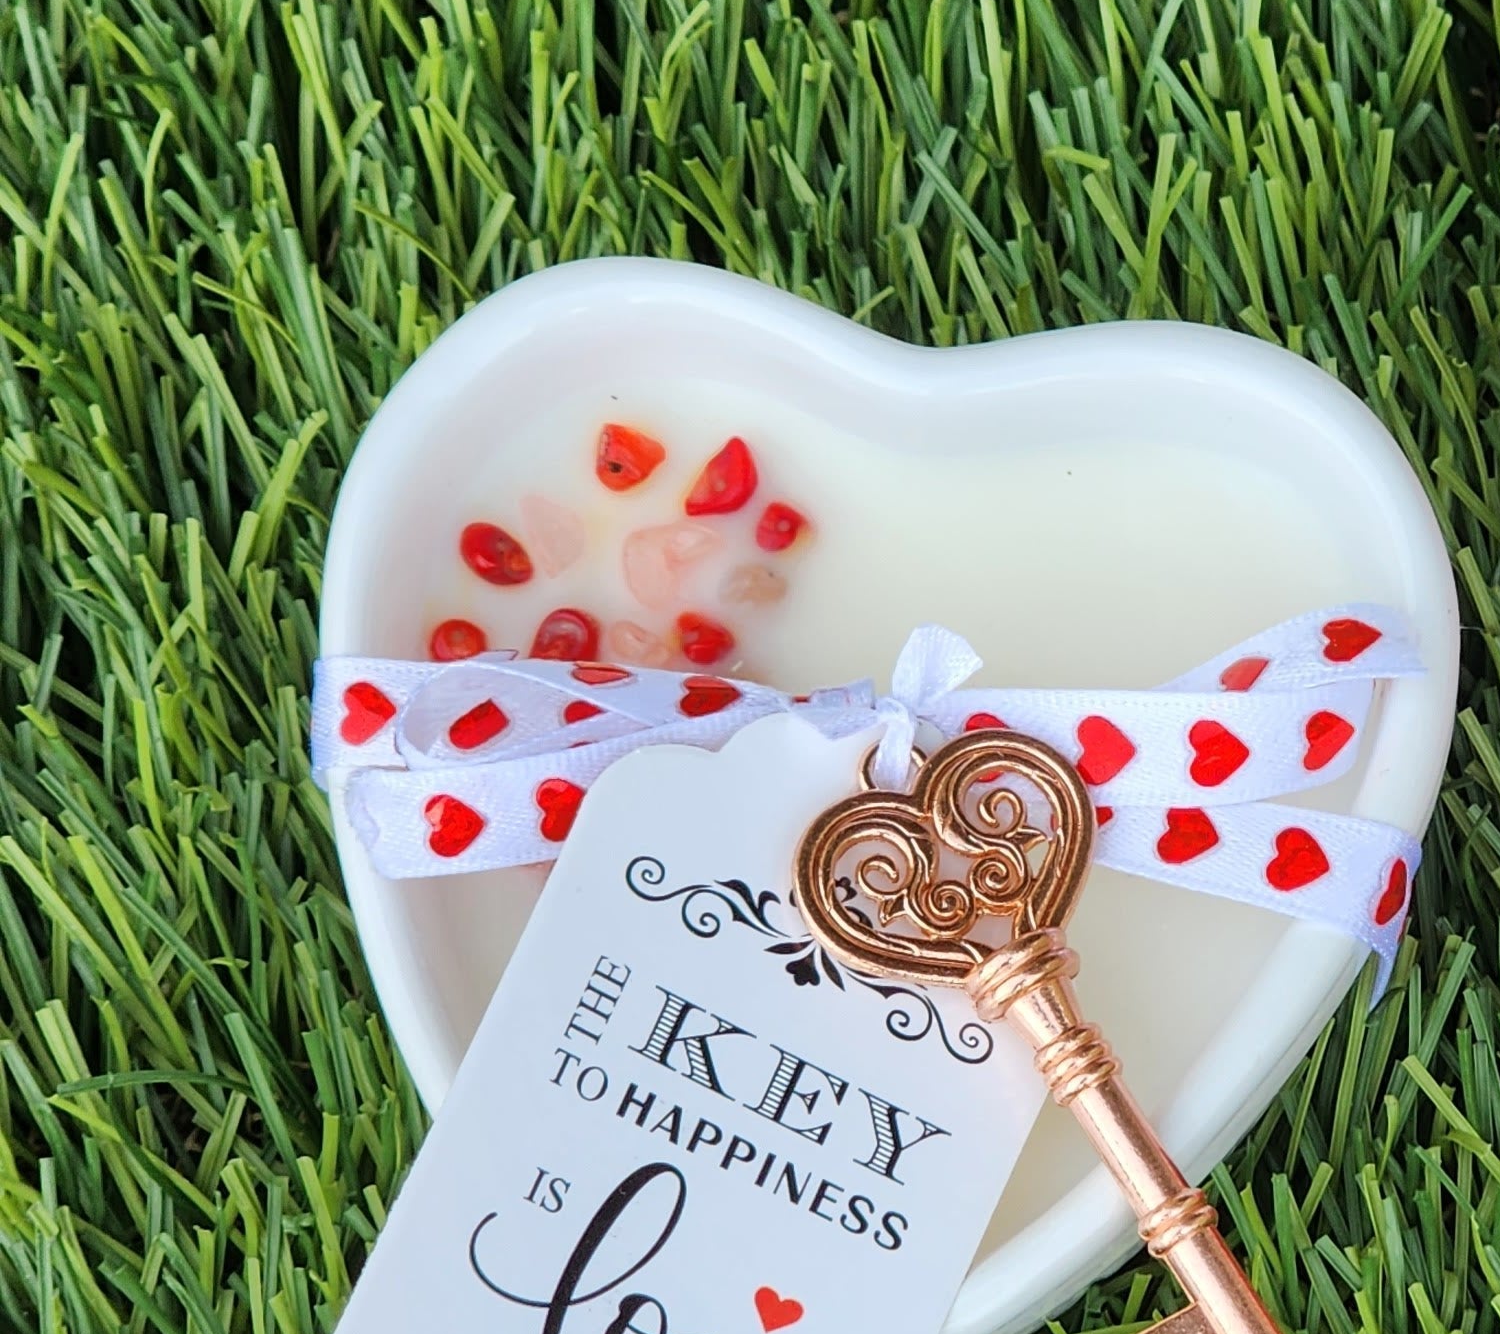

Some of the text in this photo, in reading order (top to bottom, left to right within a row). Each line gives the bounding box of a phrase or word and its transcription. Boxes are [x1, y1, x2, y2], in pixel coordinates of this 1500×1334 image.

[551, 1048, 909, 1251] TO HAPPINESS
[564, 956, 954, 1185] THE KEY
[523, 1166, 570, 1214] IS
